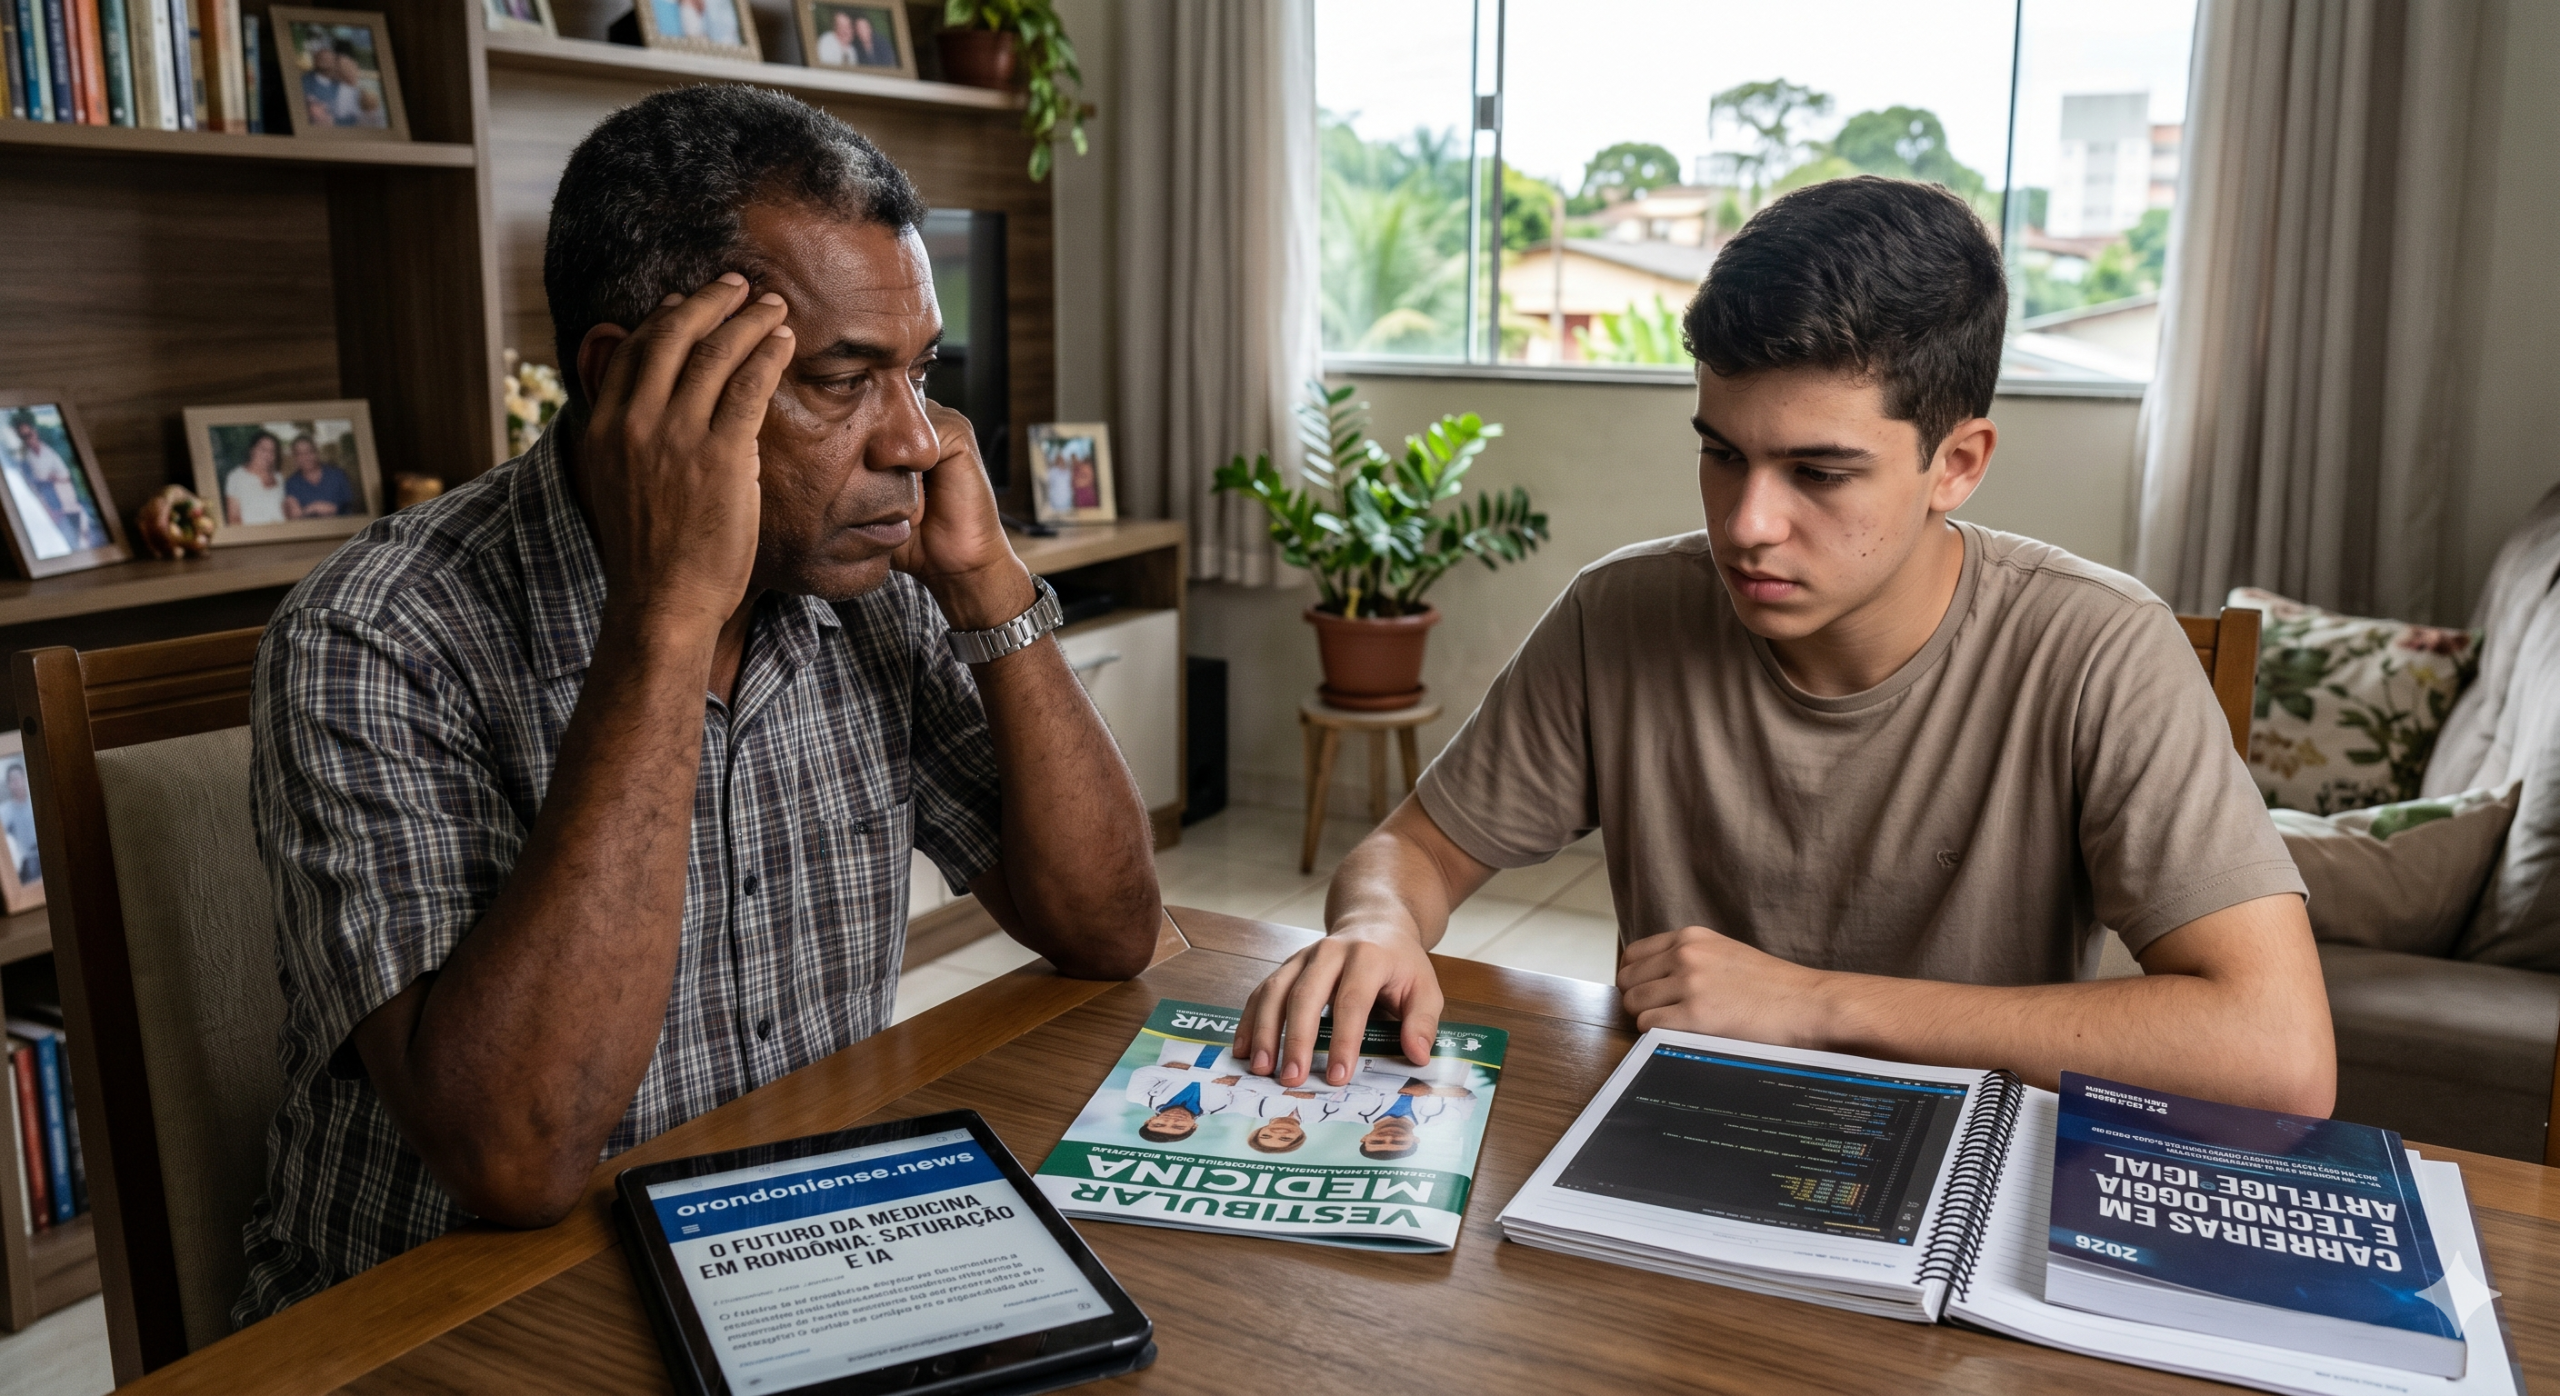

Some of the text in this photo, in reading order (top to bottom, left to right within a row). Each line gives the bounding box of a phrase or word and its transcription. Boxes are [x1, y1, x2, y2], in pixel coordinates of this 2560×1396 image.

[677, 1151, 974, 1217] orondoniense.news
[1071, 1182, 1421, 1229] VESTIBULAR
[1087, 1154, 1435, 1204] MEDICINA
[2095, 1173, 2398, 1247] E TECNOLOGGIA
[700, 1203, 1015, 1279] EM RONDÔNIA: SATURAÇÃO
[709, 1195, 982, 1258] O FUTURO DA MEDICINA
[2075, 1235, 2138, 1263] 2026
[2099, 1197, 2402, 1272] CARREIRAS EM
[844, 1249, 892, 1269] E IA
